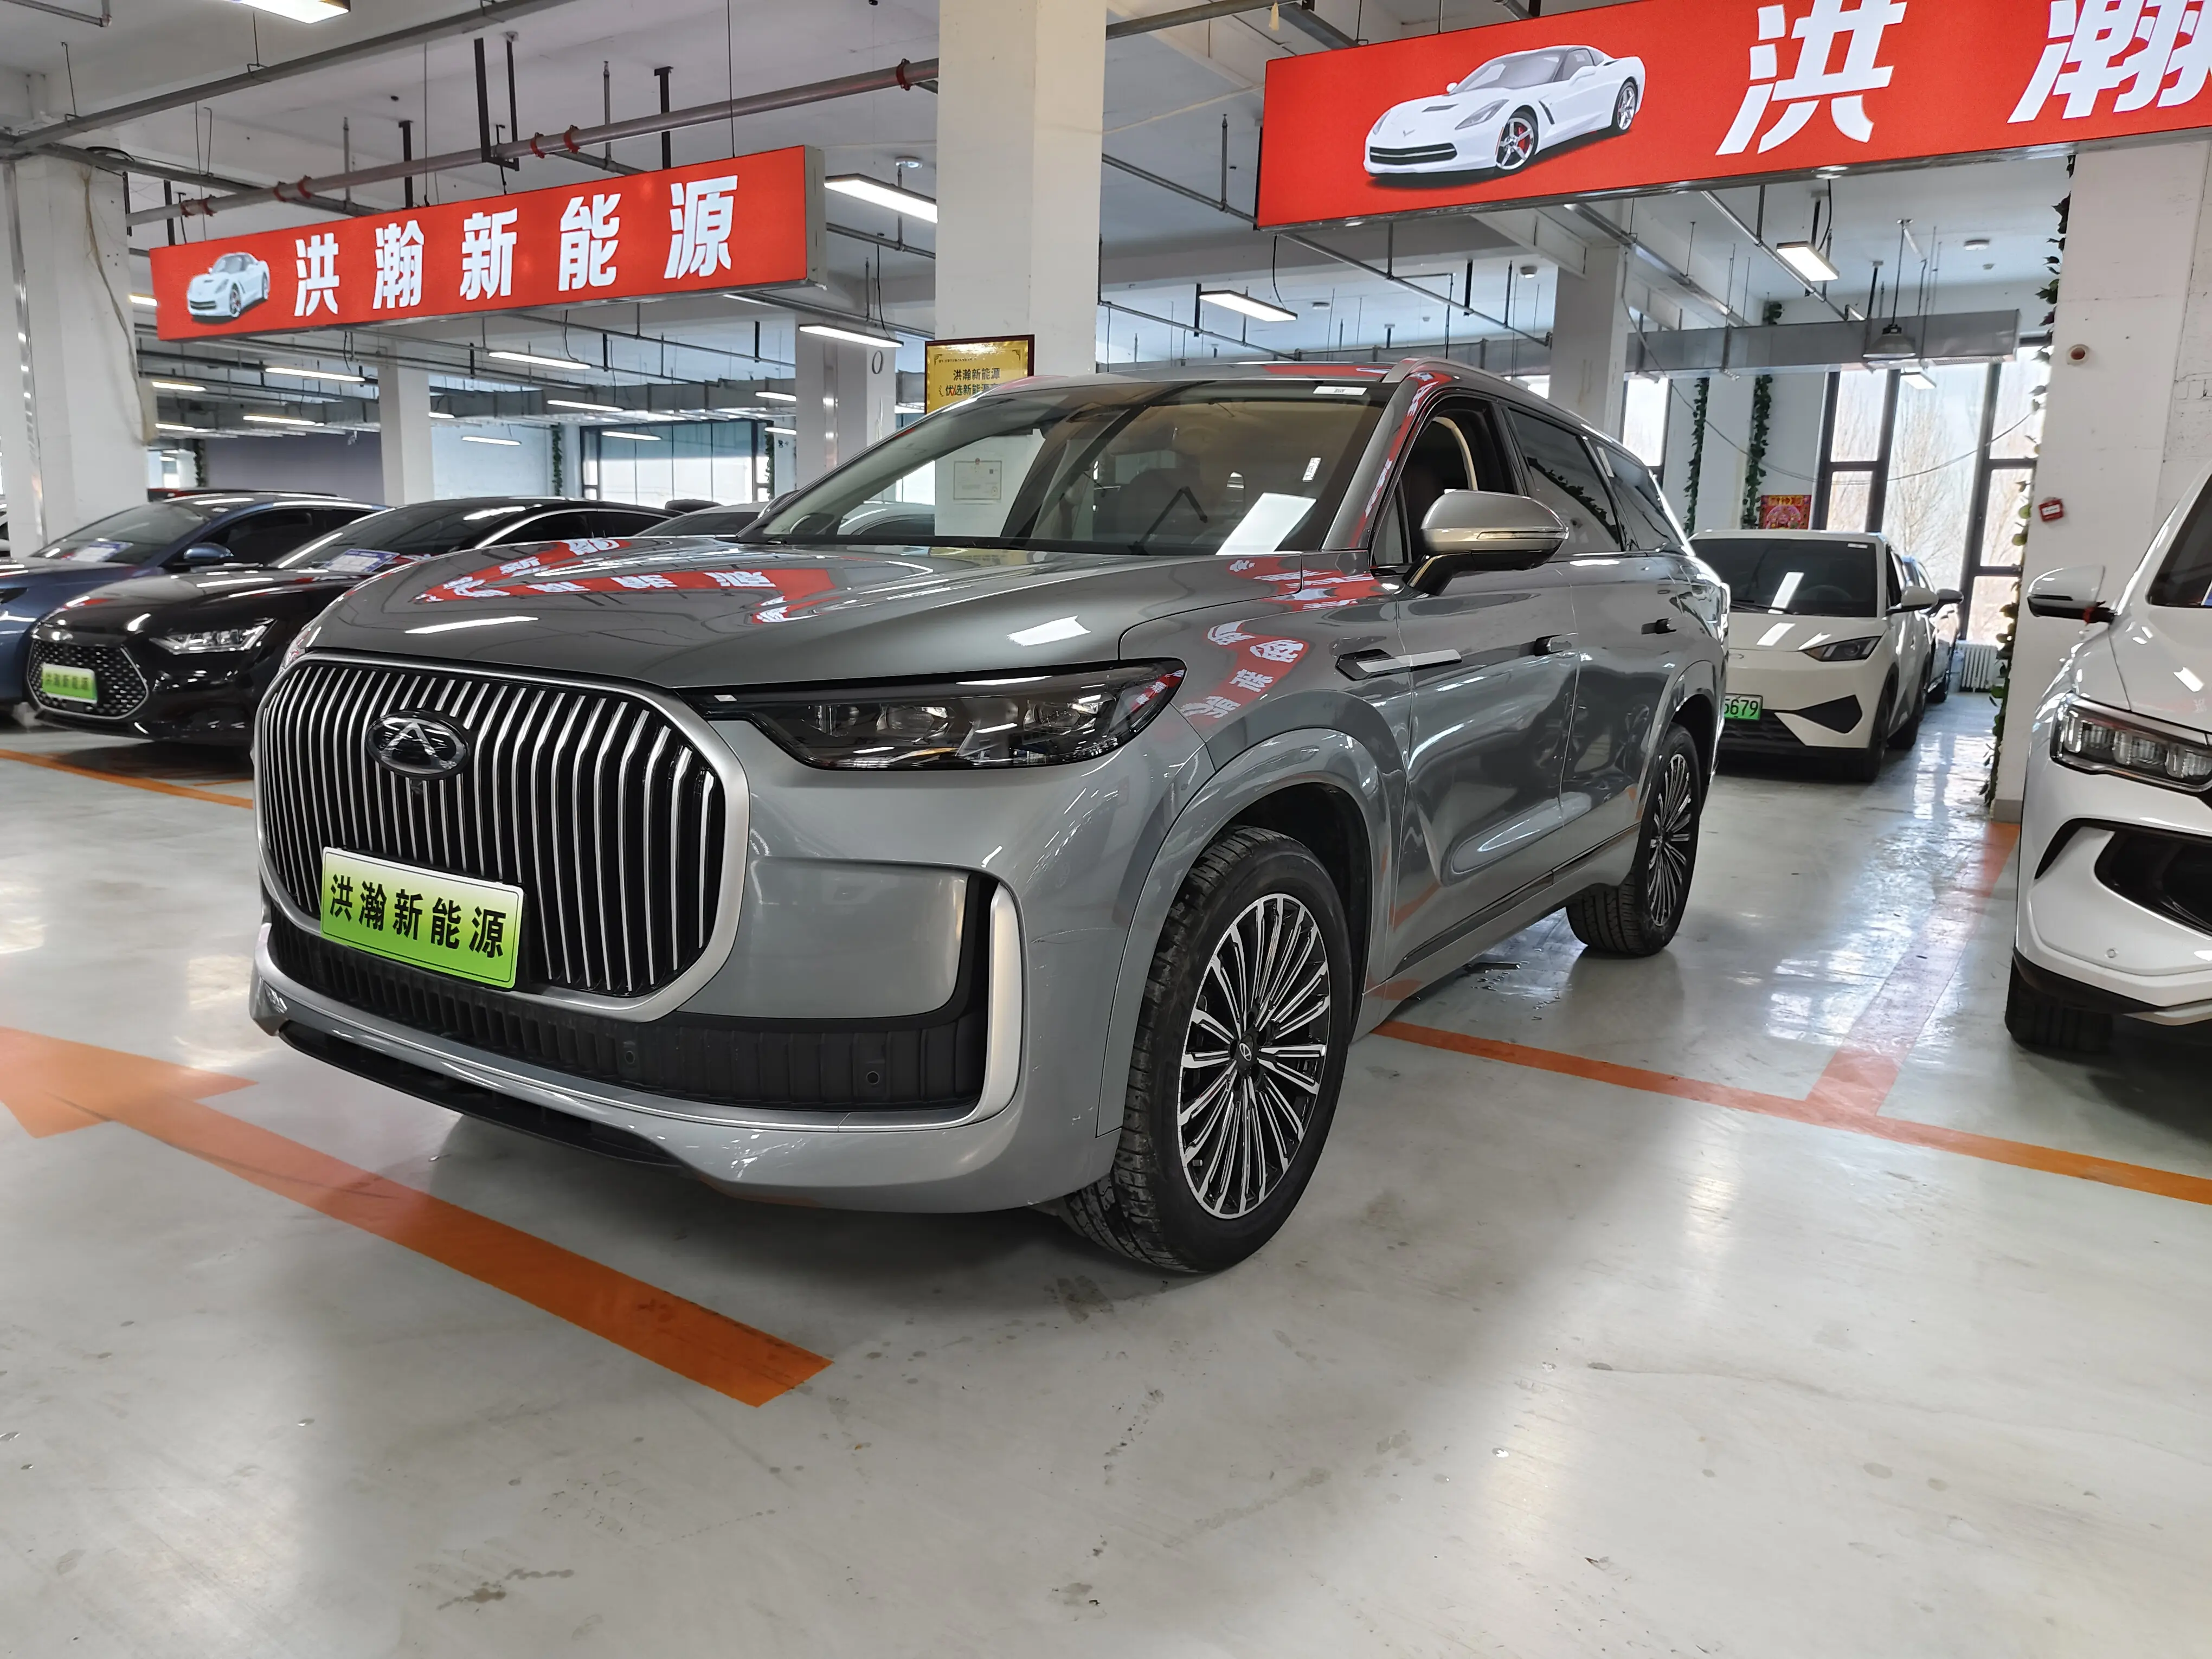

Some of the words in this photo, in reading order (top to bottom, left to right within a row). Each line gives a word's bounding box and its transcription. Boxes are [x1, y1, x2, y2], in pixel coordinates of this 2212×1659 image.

[293, 175, 738, 318] 洪瀚新能源
[953, 368, 1000, 381] 洪瀚新能源
[330, 874, 506, 959] 洪瀚新能源
